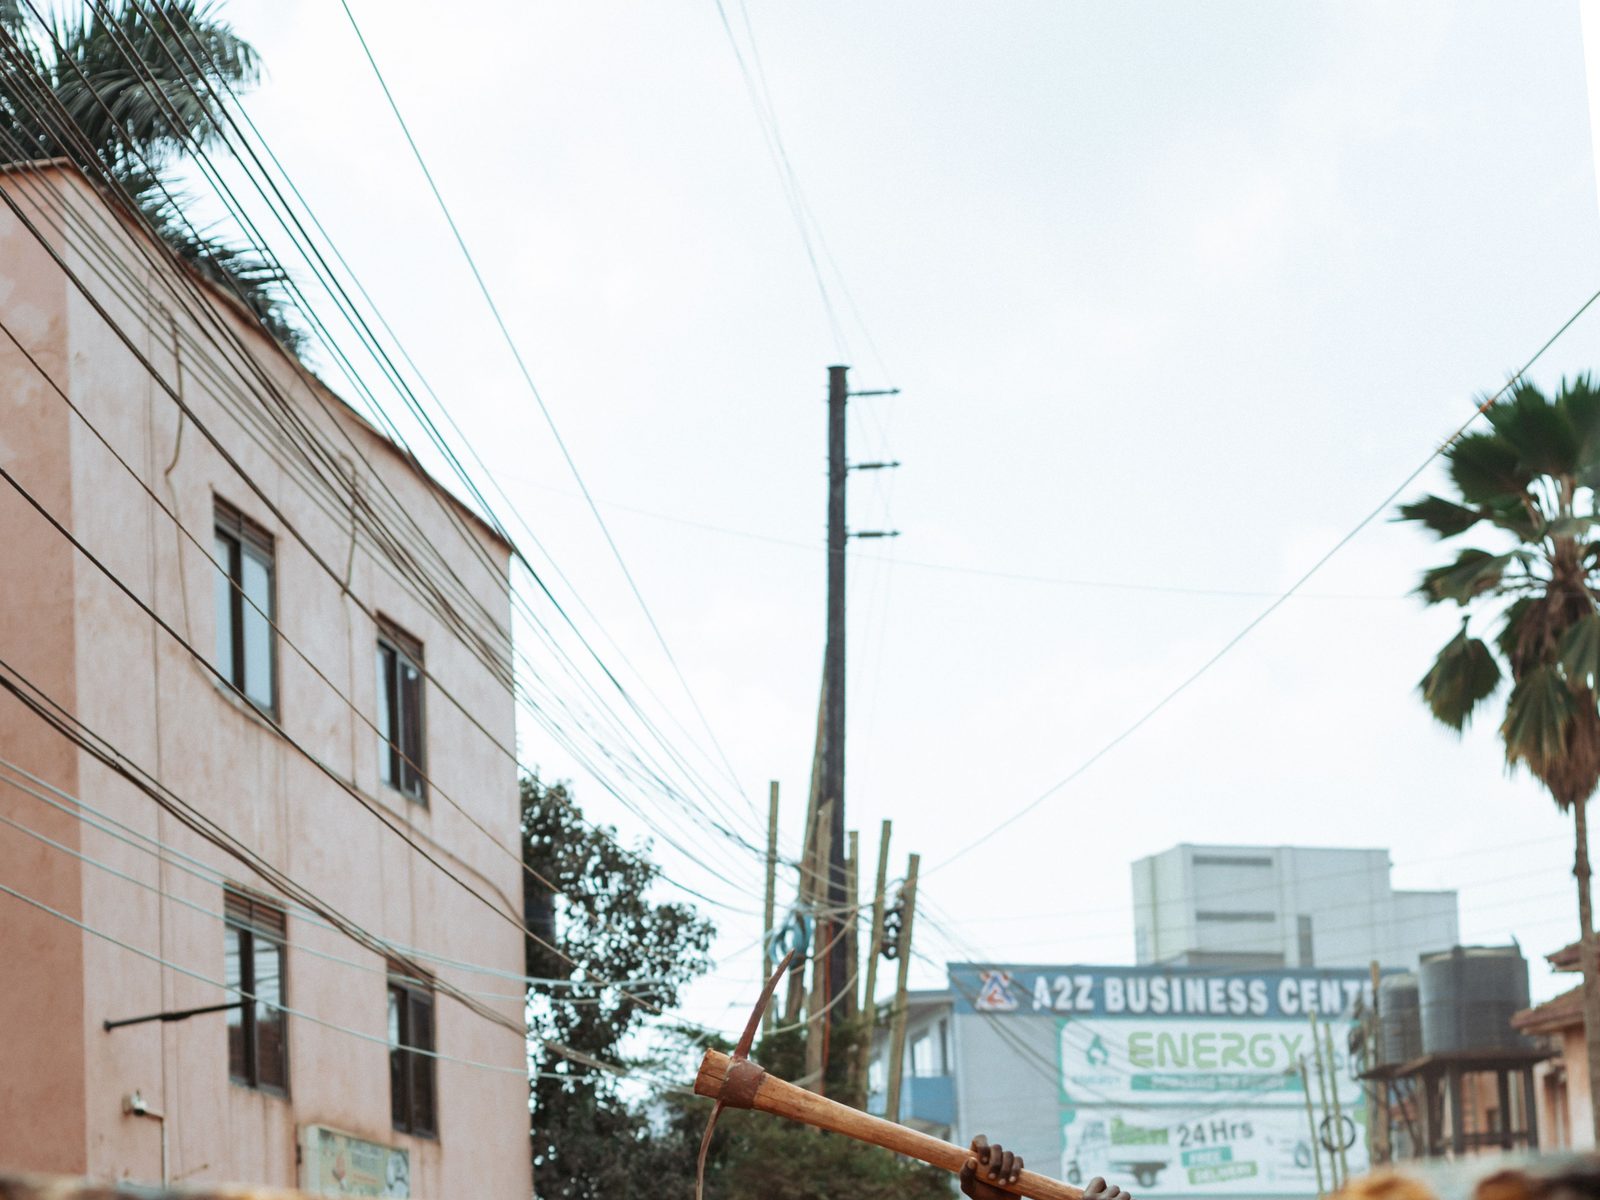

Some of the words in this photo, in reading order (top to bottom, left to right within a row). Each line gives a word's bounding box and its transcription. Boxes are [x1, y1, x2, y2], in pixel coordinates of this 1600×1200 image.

[1033, 975, 1094, 1011] A2Z
[1104, 976, 1269, 1014] BUSINESS
[1128, 1031, 1304, 1069] ENERGY
